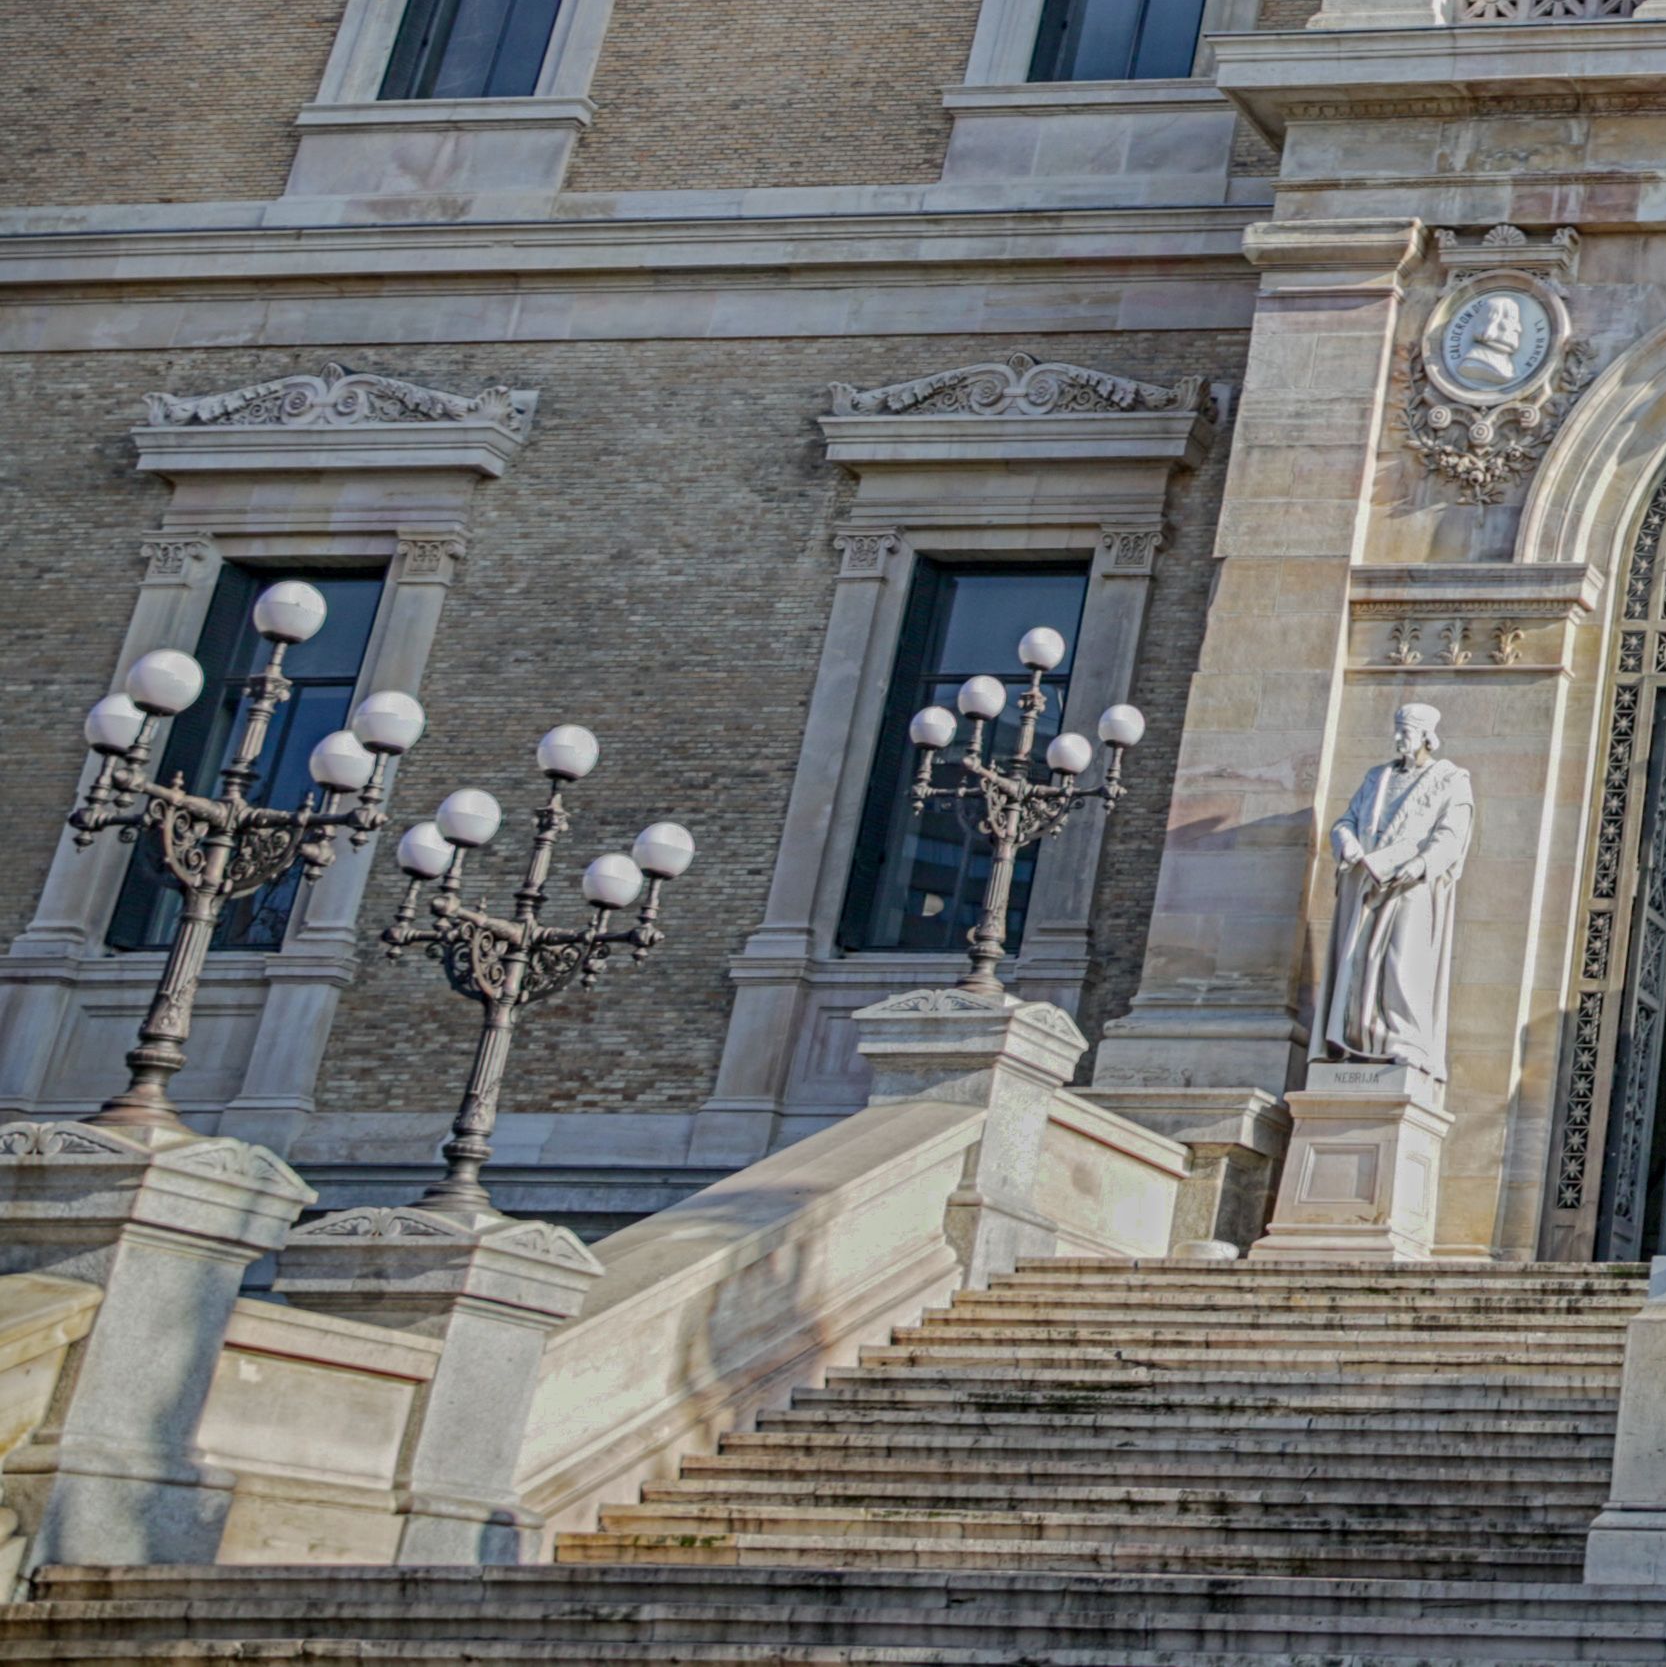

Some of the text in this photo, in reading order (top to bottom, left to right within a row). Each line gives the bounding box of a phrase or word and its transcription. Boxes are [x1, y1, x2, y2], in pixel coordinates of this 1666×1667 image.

[1450, 310, 1474, 360] CALDERON
[1534, 319, 1545, 334] LA
[1335, 1072, 1379, 1084] NEBRIJA
